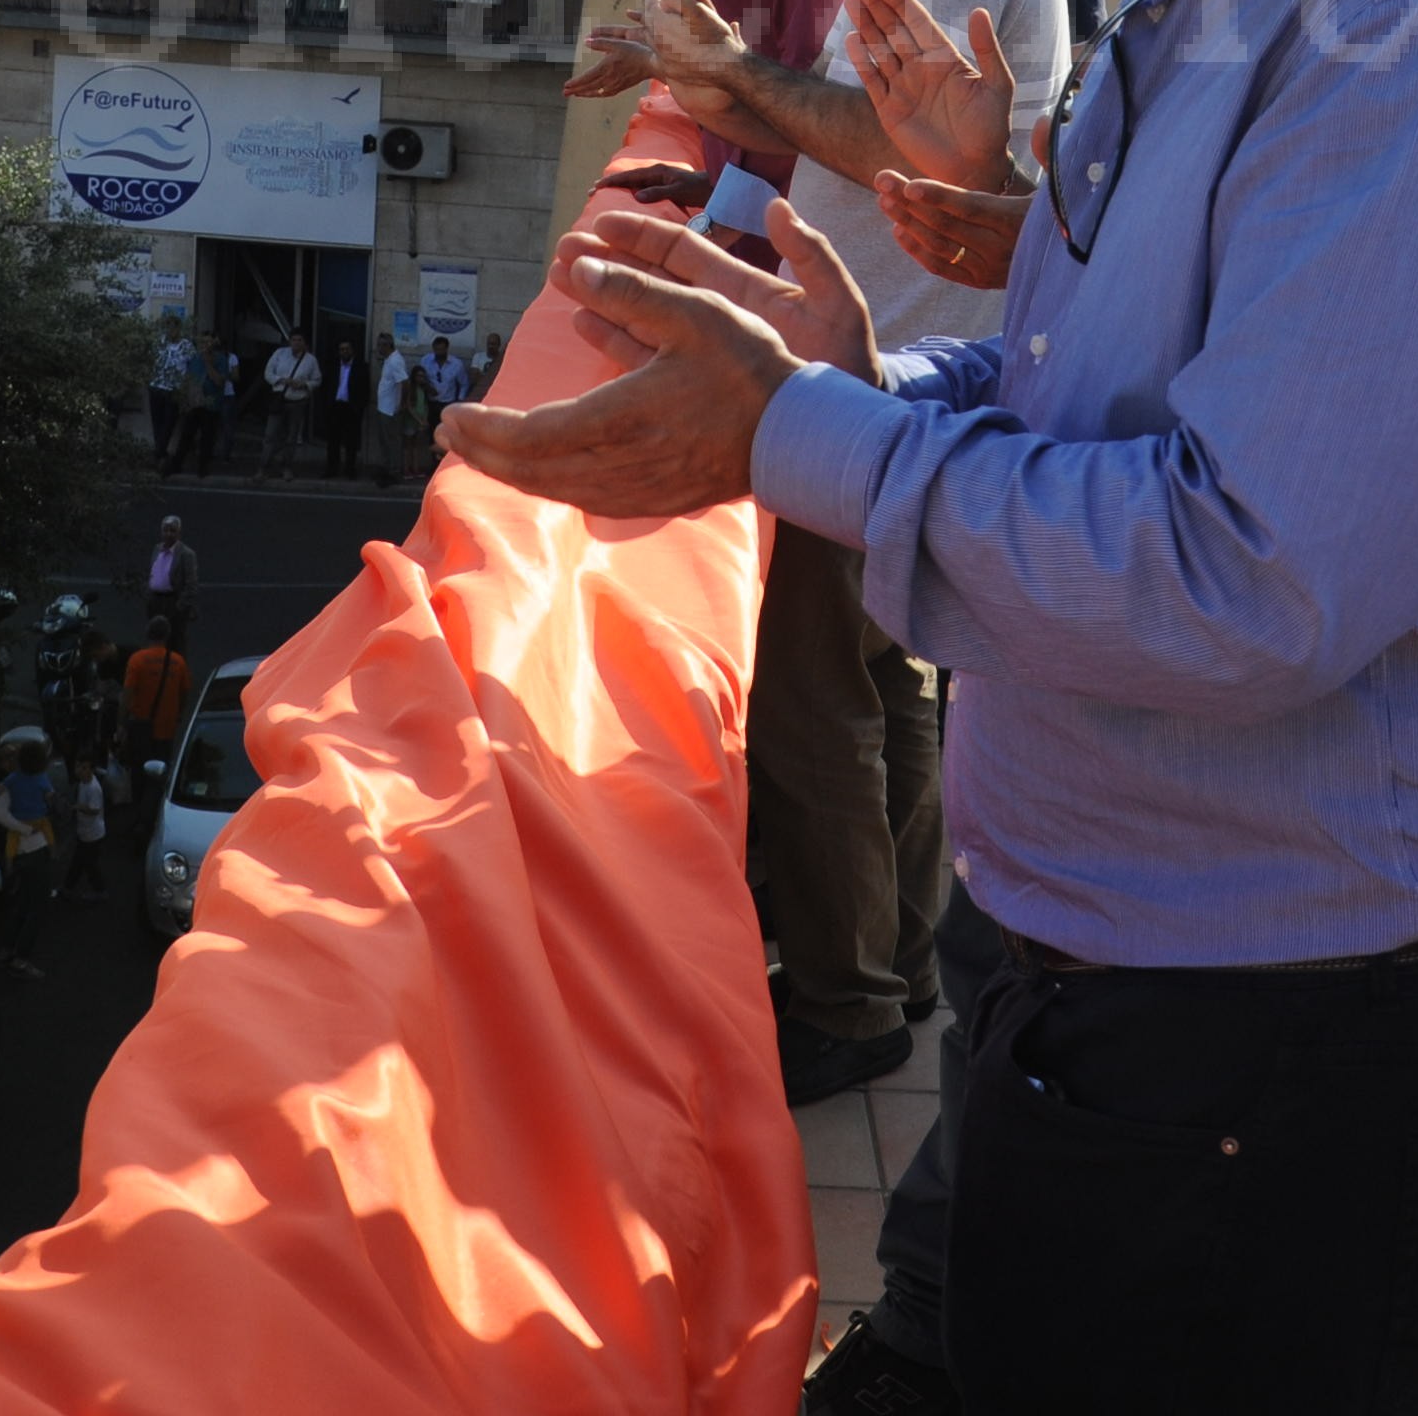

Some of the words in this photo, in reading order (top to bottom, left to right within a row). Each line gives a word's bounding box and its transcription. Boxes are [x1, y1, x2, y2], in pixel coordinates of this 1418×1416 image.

[83, 89, 192, 112] F@reFuturo
[232, 143, 282, 157] INSIEME
[87, 177, 182, 203] ROCCO
[102, 199, 166, 216] SINDACO
